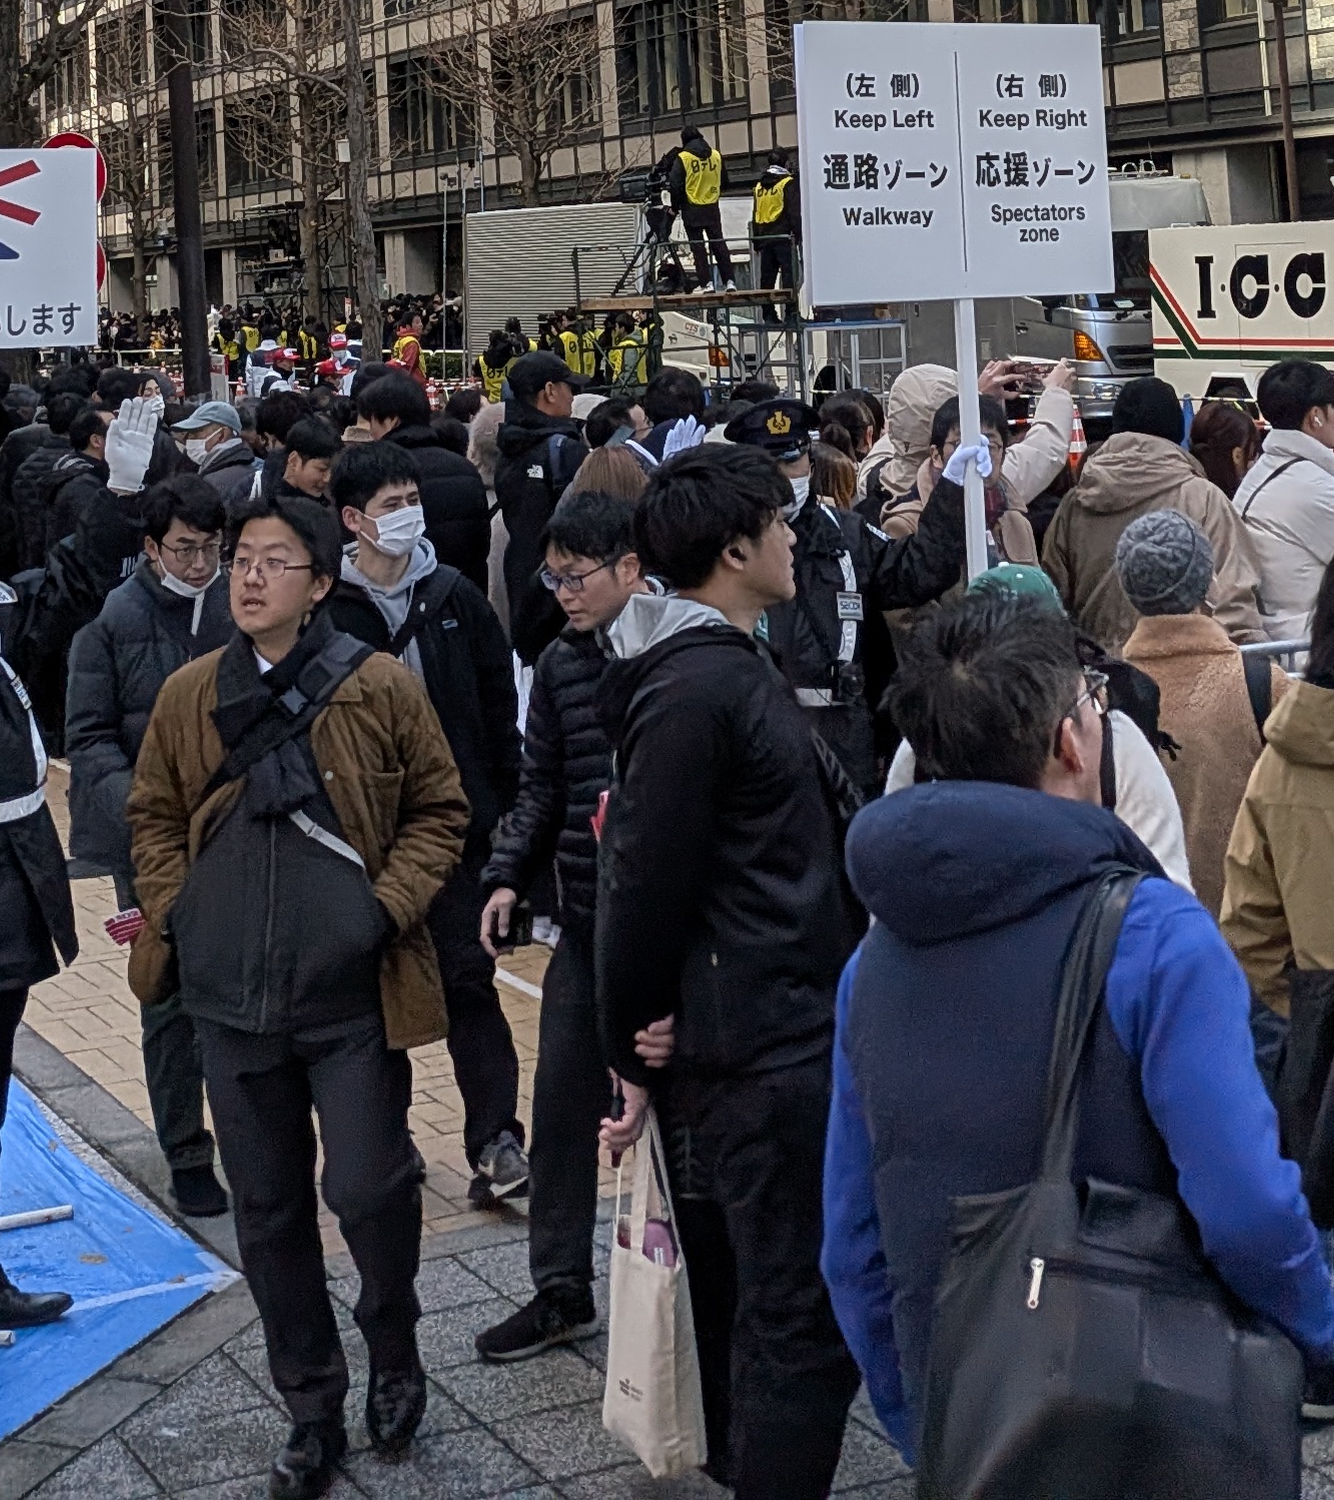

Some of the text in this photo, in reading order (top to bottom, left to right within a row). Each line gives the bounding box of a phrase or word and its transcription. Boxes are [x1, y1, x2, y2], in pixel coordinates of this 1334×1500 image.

[834, 109, 934, 131] Keep Left
[979, 108, 1088, 130] Keep Right
[823, 153, 948, 190] 通路ゾーン
[975, 151, 1096, 189] 応援ゾーン
[842, 207, 934, 228] Walkway
[990, 204, 1086, 226] Spectators
[1019, 227, 1060, 243] zone
